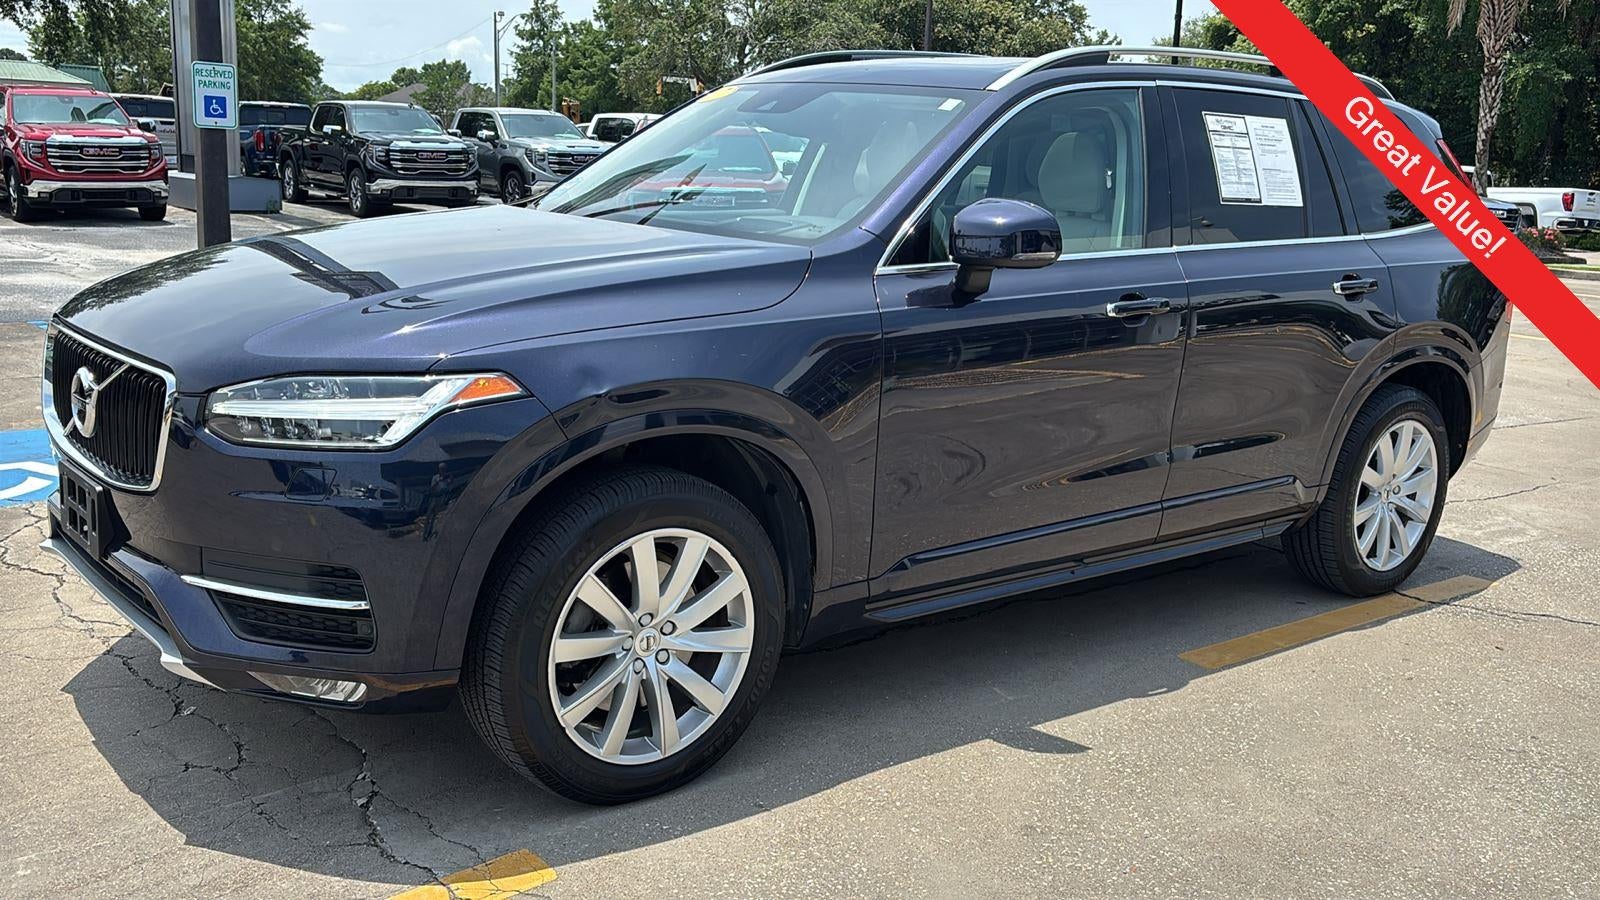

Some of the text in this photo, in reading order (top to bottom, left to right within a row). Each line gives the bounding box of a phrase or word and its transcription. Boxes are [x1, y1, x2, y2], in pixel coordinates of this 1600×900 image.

[195, 68, 233, 79] RESERVED
[198, 80, 231, 90] PARKING
[82, 147, 120, 156] GMC
